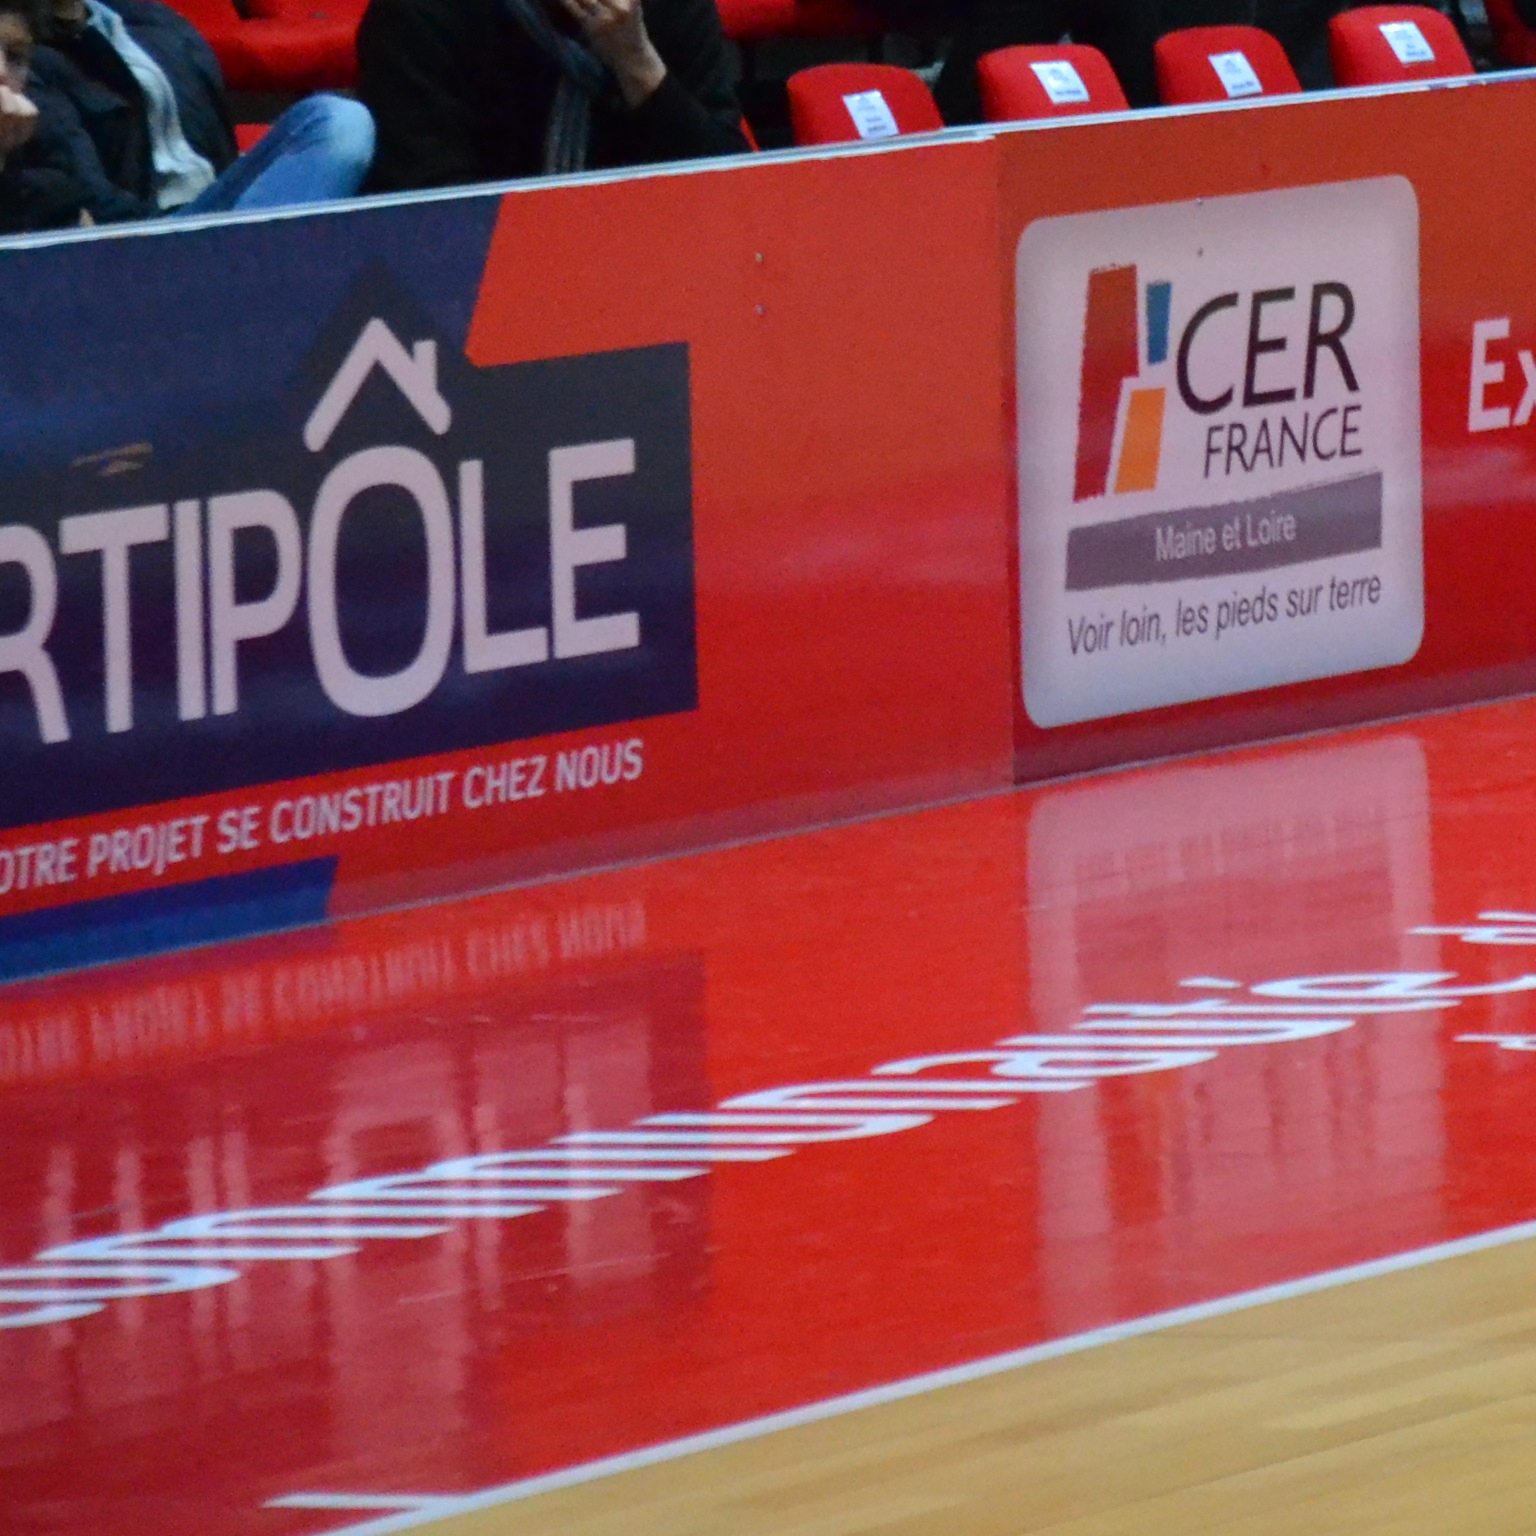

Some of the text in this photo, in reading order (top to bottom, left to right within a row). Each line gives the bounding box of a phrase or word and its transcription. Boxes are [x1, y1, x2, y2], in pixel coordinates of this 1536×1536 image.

[1176, 281, 1360, 416] CER
[1202, 403, 1363, 480] FRANCE
[1155, 511, 1297, 562] Maine et Loire
[1067, 573, 1382, 656] Voir loin, les pieds sur terre
[86, 814, 207, 877] PROJET
[217, 804, 264, 854] SE
[270, 772, 455, 845] CONSTRUIT
[462, 755, 547, 810] CHEZ
[554, 738, 645, 794] NOUS
